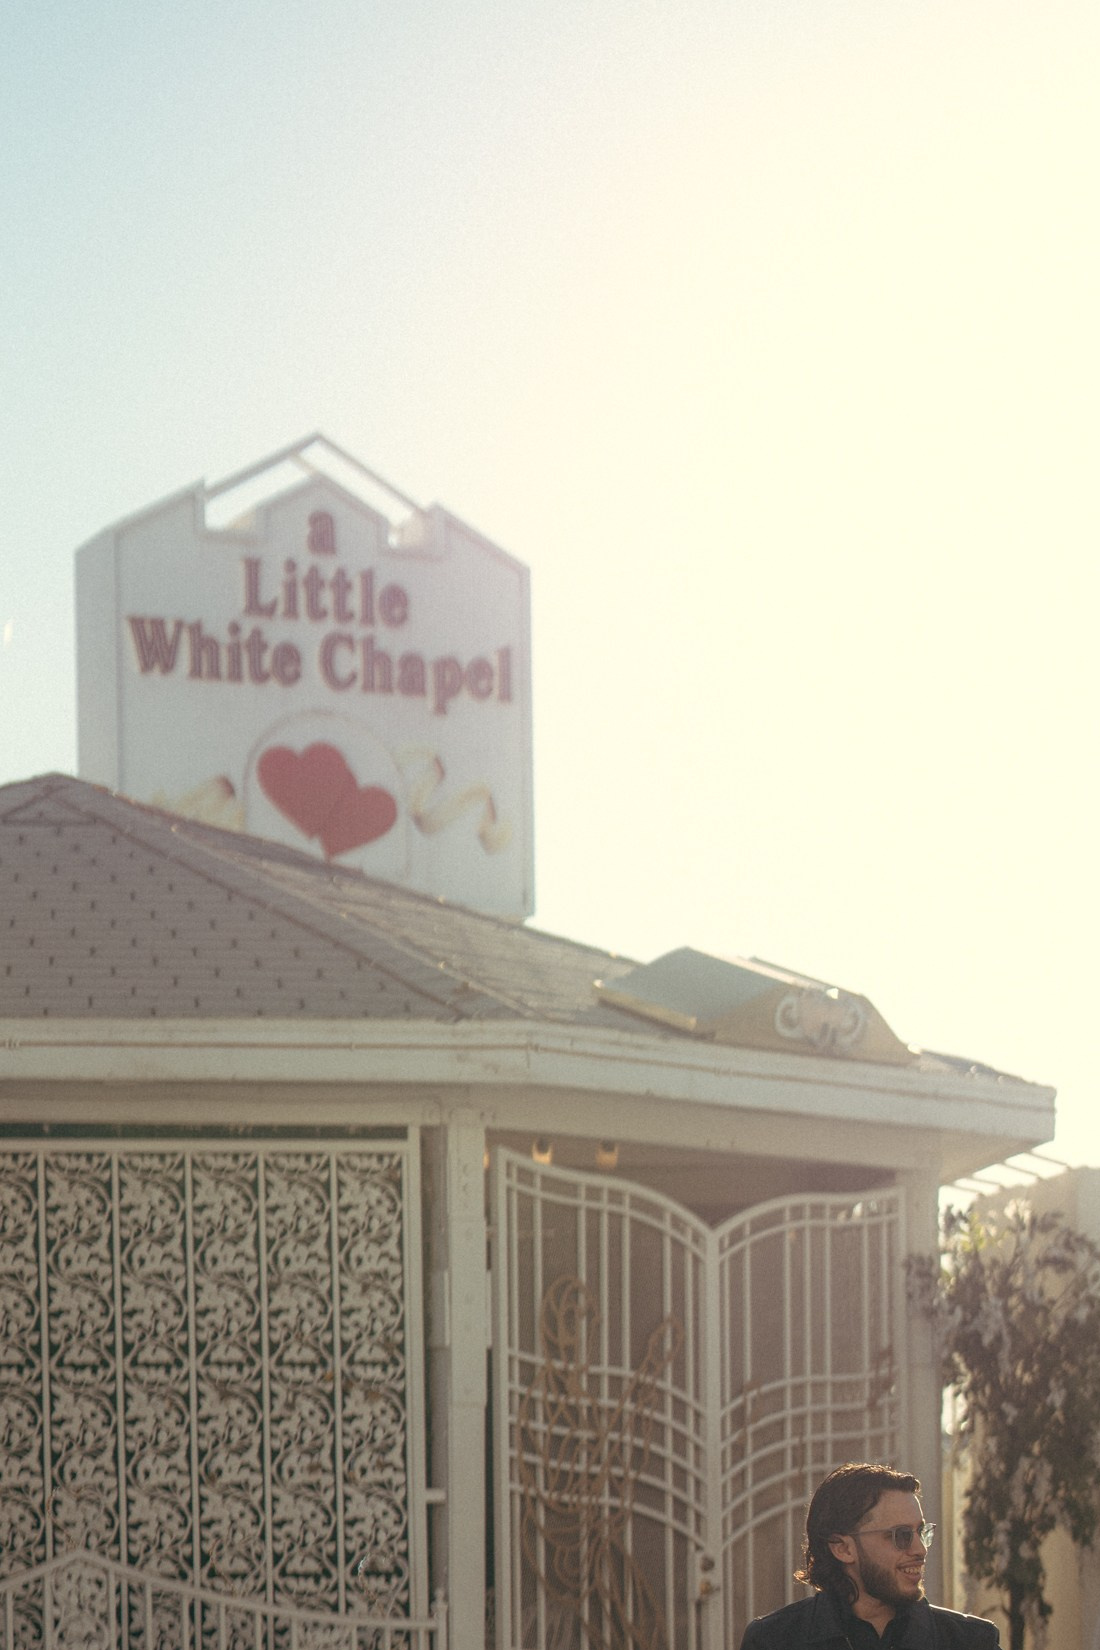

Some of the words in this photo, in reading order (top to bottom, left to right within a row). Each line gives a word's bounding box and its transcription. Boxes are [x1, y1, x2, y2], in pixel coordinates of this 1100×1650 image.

[307, 510, 337, 556] a
[241, 557, 411, 628] Little
[127, 614, 304, 687] White
[319, 631, 514, 716] Chapel
